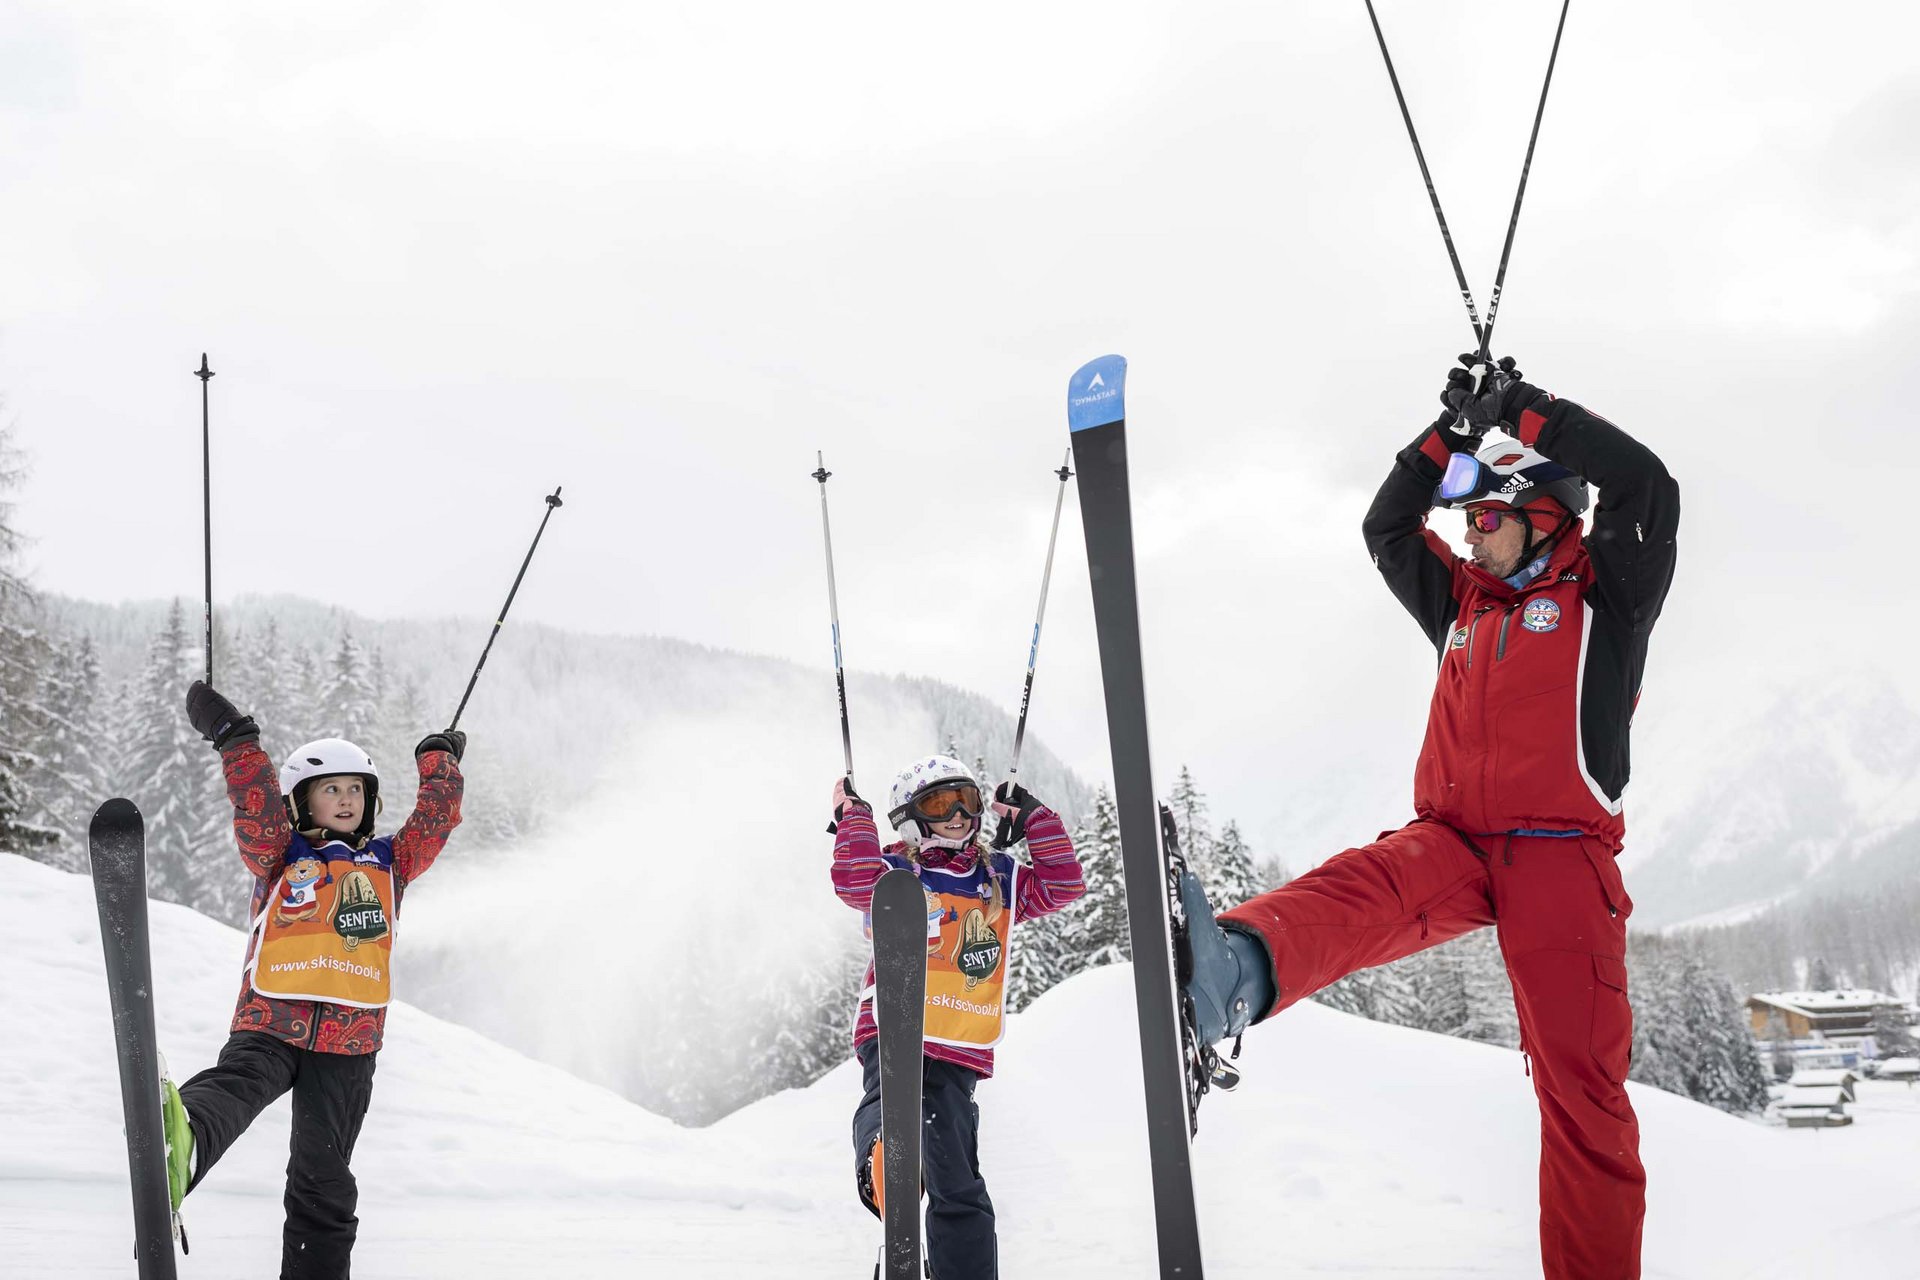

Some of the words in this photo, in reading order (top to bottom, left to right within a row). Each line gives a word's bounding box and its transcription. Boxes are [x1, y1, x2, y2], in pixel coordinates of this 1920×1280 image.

[1075, 388, 1116, 406] DYNASTAR
[1500, 480, 1535, 493] adidas
[270, 954, 381, 983] www.skischool.it
[924, 993, 1000, 1017] .skischool.it
